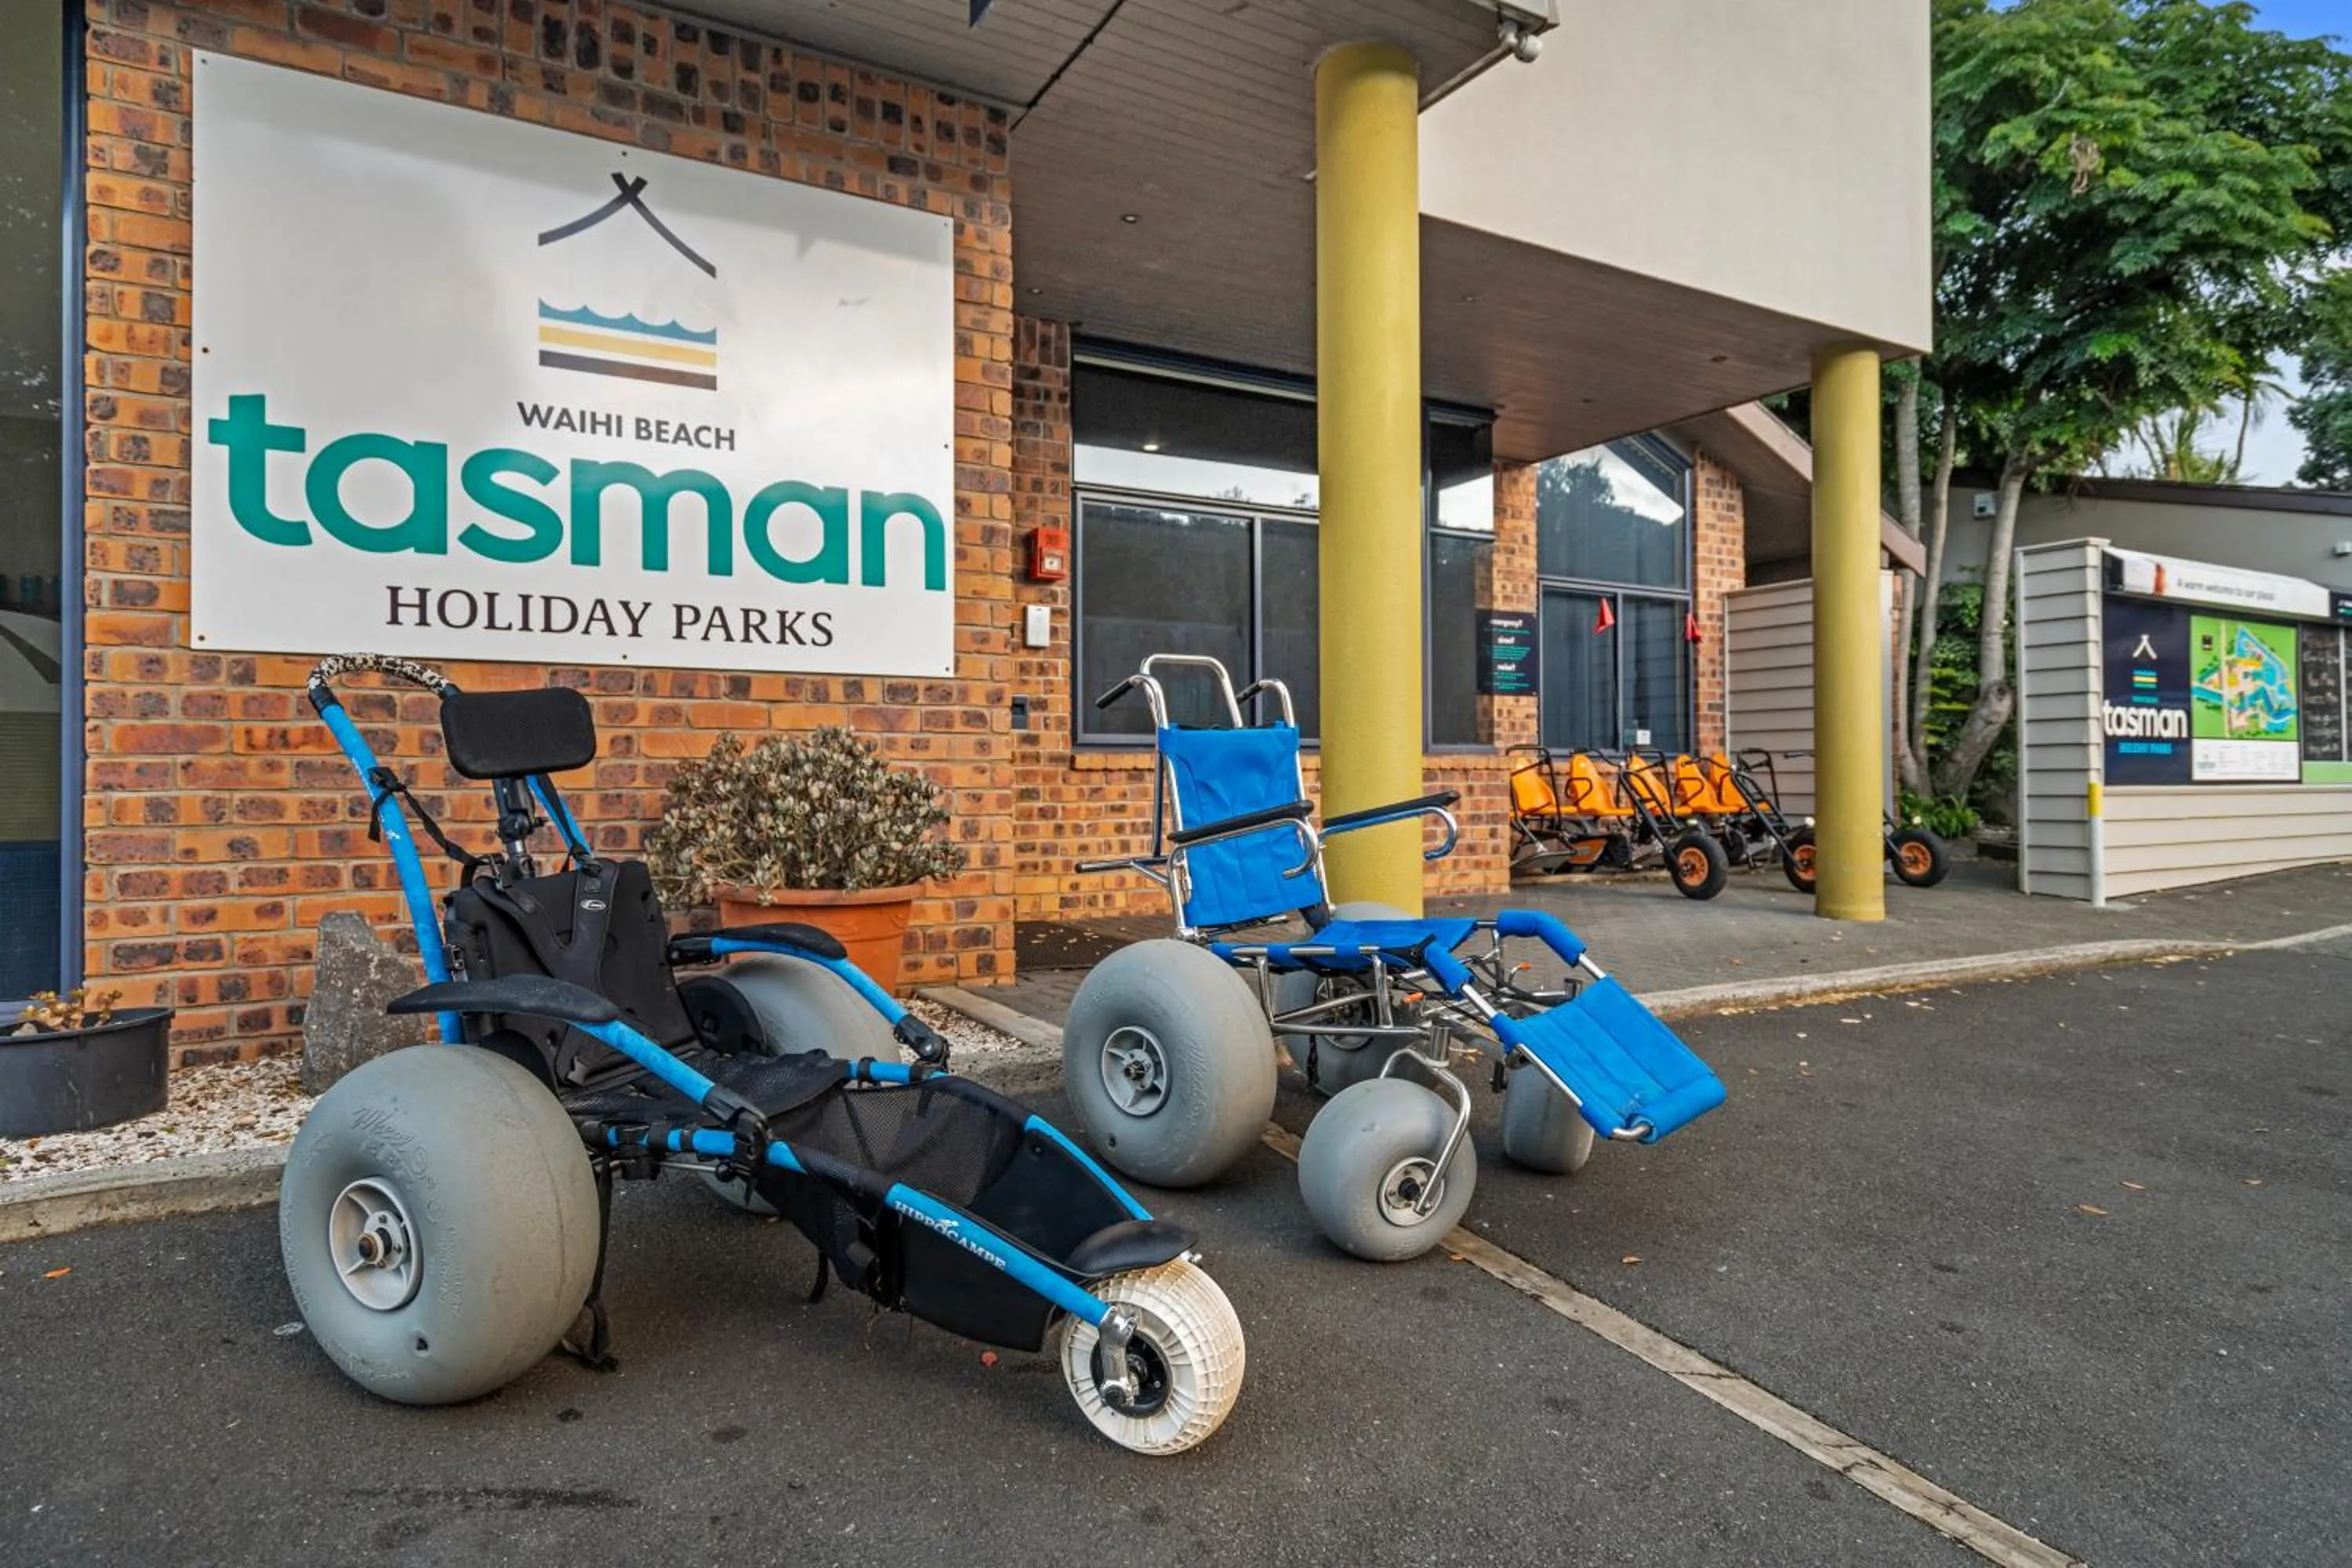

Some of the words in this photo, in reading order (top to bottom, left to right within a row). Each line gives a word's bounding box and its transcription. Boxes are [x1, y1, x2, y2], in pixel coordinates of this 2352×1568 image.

[517, 401, 622, 437] WAIHI
[634, 416, 735, 452] BEACH
[209, 395, 946, 590] tasman
[385, 586, 652, 638] HOLIDAY
[672, 603, 834, 648] PARKS
[2103, 699, 2188, 739] tasman
